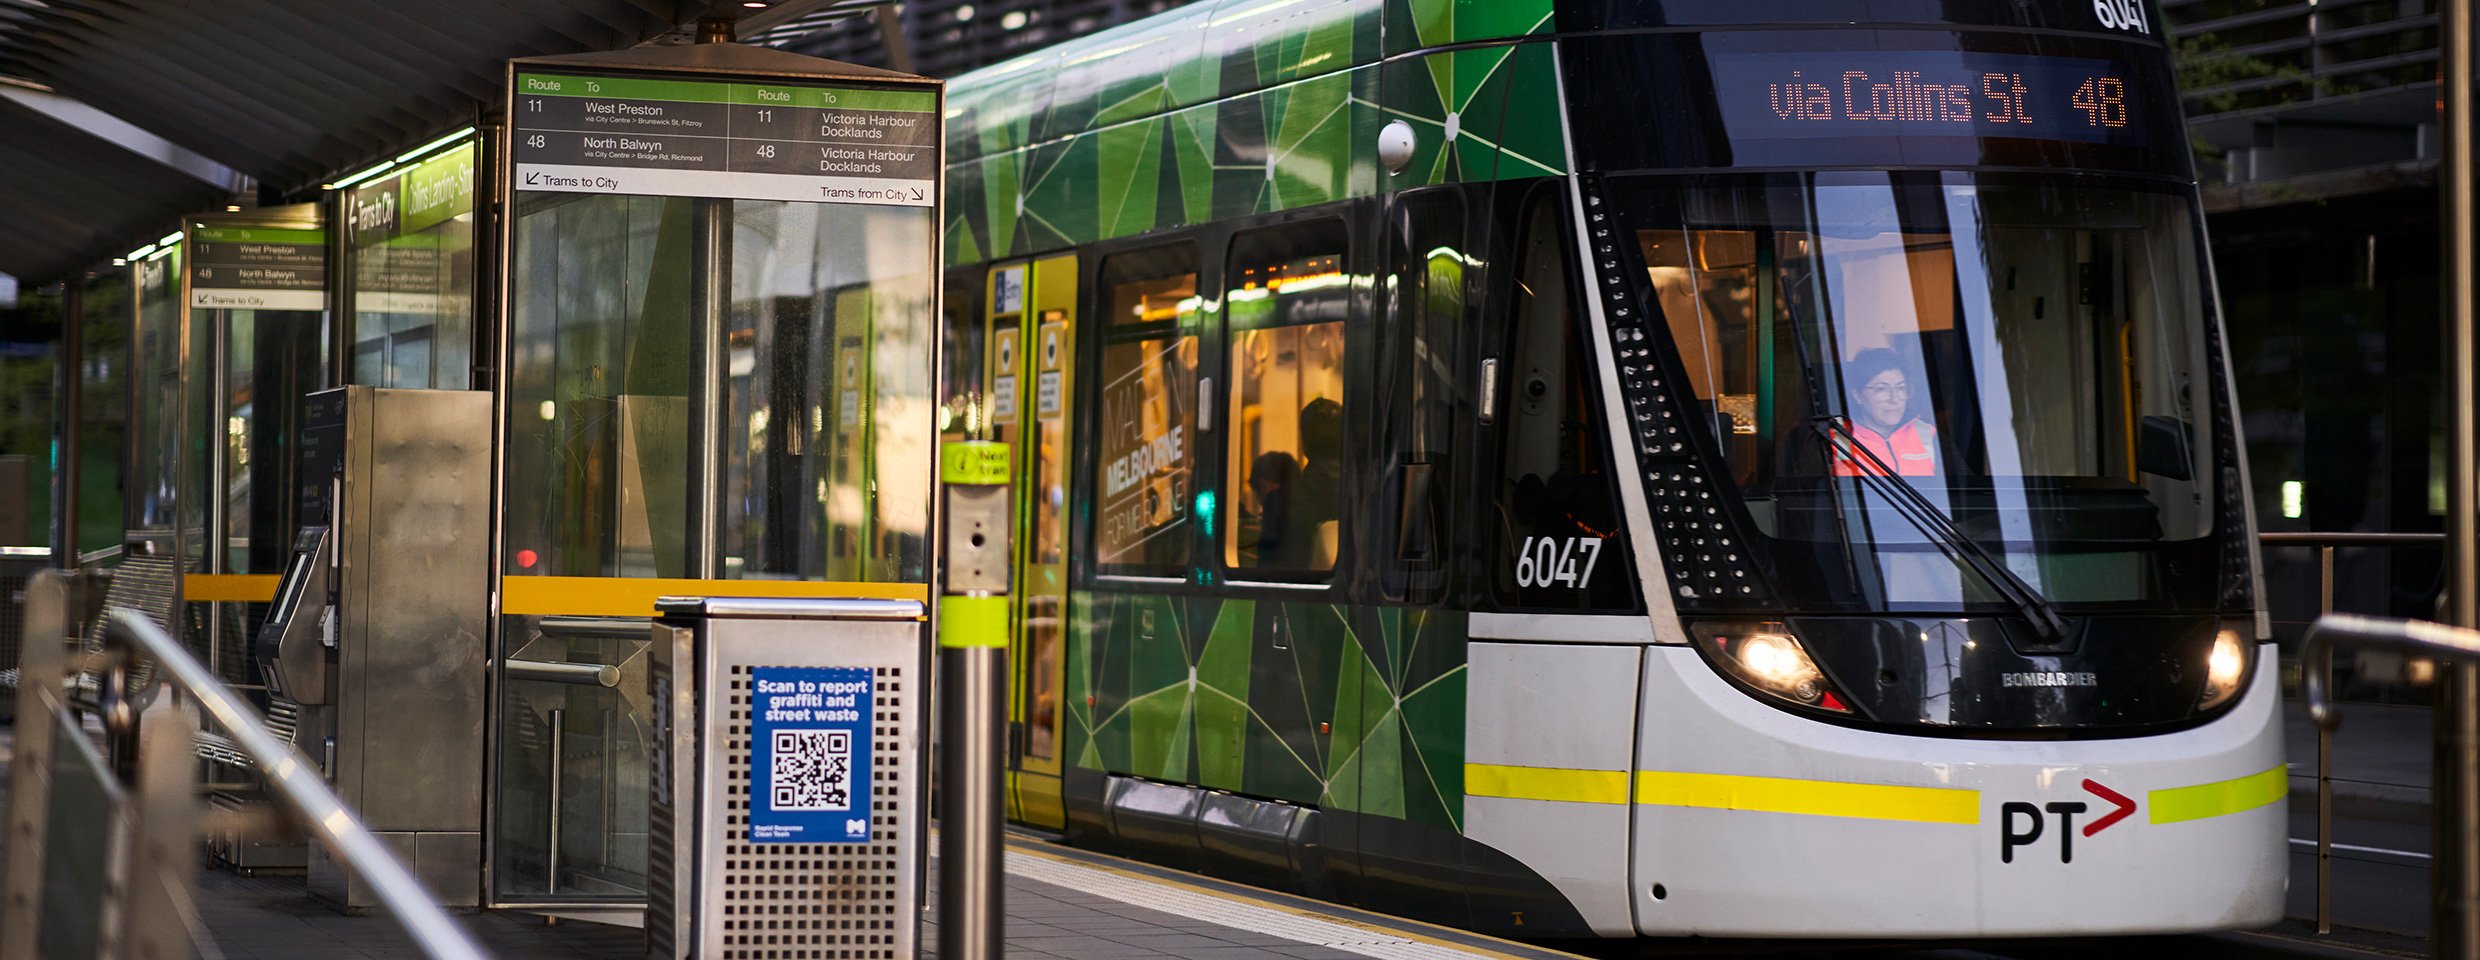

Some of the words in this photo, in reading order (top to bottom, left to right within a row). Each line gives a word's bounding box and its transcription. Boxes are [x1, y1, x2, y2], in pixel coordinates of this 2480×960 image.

[528, 78, 561, 91] Route
[586, 81, 600, 93] To
[757, 90, 790, 102] Route
[823, 92, 837, 104] To
[1769, 70, 1832, 121] via
[1842, 70, 1973, 122] Collins
[1983, 72, 2033, 124] St
[2072, 76, 2127, 128] 48
[528, 99, 542, 112] 11
[585, 102, 615, 114] West
[618, 103, 663, 116] Preston
[596, 115, 608, 124] City
[610, 116, 631, 124] Centre
[638, 118, 670, 126] Brunswick
[681, 119, 703, 128] Fitzroy
[757, 110, 772, 123] 11
[822, 113, 866, 125] Victoria
[869, 115, 916, 127] Harbour
[821, 126, 883, 139] Docklands
[527, 134, 546, 149] 48
[584, 136, 617, 149] North
[620, 138, 662, 153] Balwyn
[595, 151, 608, 159] City
[609, 151, 630, 159] Centre
[637, 152, 658, 161] Bridge
[671, 154, 704, 162] Richmond
[756, 144, 775, 158] 48
[821, 147, 865, 160] Victoria
[868, 150, 915, 162] Harbour
[820, 161, 882, 173] Docklands
[543, 175, 578, 187] Trams
[581, 176, 593, 188] to
[596, 177, 619, 190] City
[408, 181, 429, 216] Collins
[429, 171, 455, 209] Landing
[821, 186, 855, 199] Trams
[858, 187, 883, 199] from
[886, 189, 908, 202] City
[358, 200, 375, 231] Trams
[375, 197, 381, 226] to
[382, 192, 394, 229] City
[241, 231, 251, 239] To
[200, 243, 210, 254] 11
[240, 245, 261, 254] West
[263, 245, 296, 255] Preston
[199, 268, 212, 279] 48
[239, 268, 263, 278] North
[264, 269, 295, 281] Balwyn
[210, 295, 236, 305] Trams
[238, 295, 246, 305] to
[248, 296, 265, 307] City
[1106, 425, 1184, 498] MELBOURNE
[1516, 536, 1603, 589] 6047
[2002, 672, 2097, 687] BOMBARDIER
[757, 679, 796, 694] Scan
[798, 680, 816, 694] to
[819, 680, 868, 696] report
[769, 693, 823, 710] graffiti
[825, 694, 855, 708] and
[765, 708, 811, 722] street
[814, 709, 860, 722] waste
